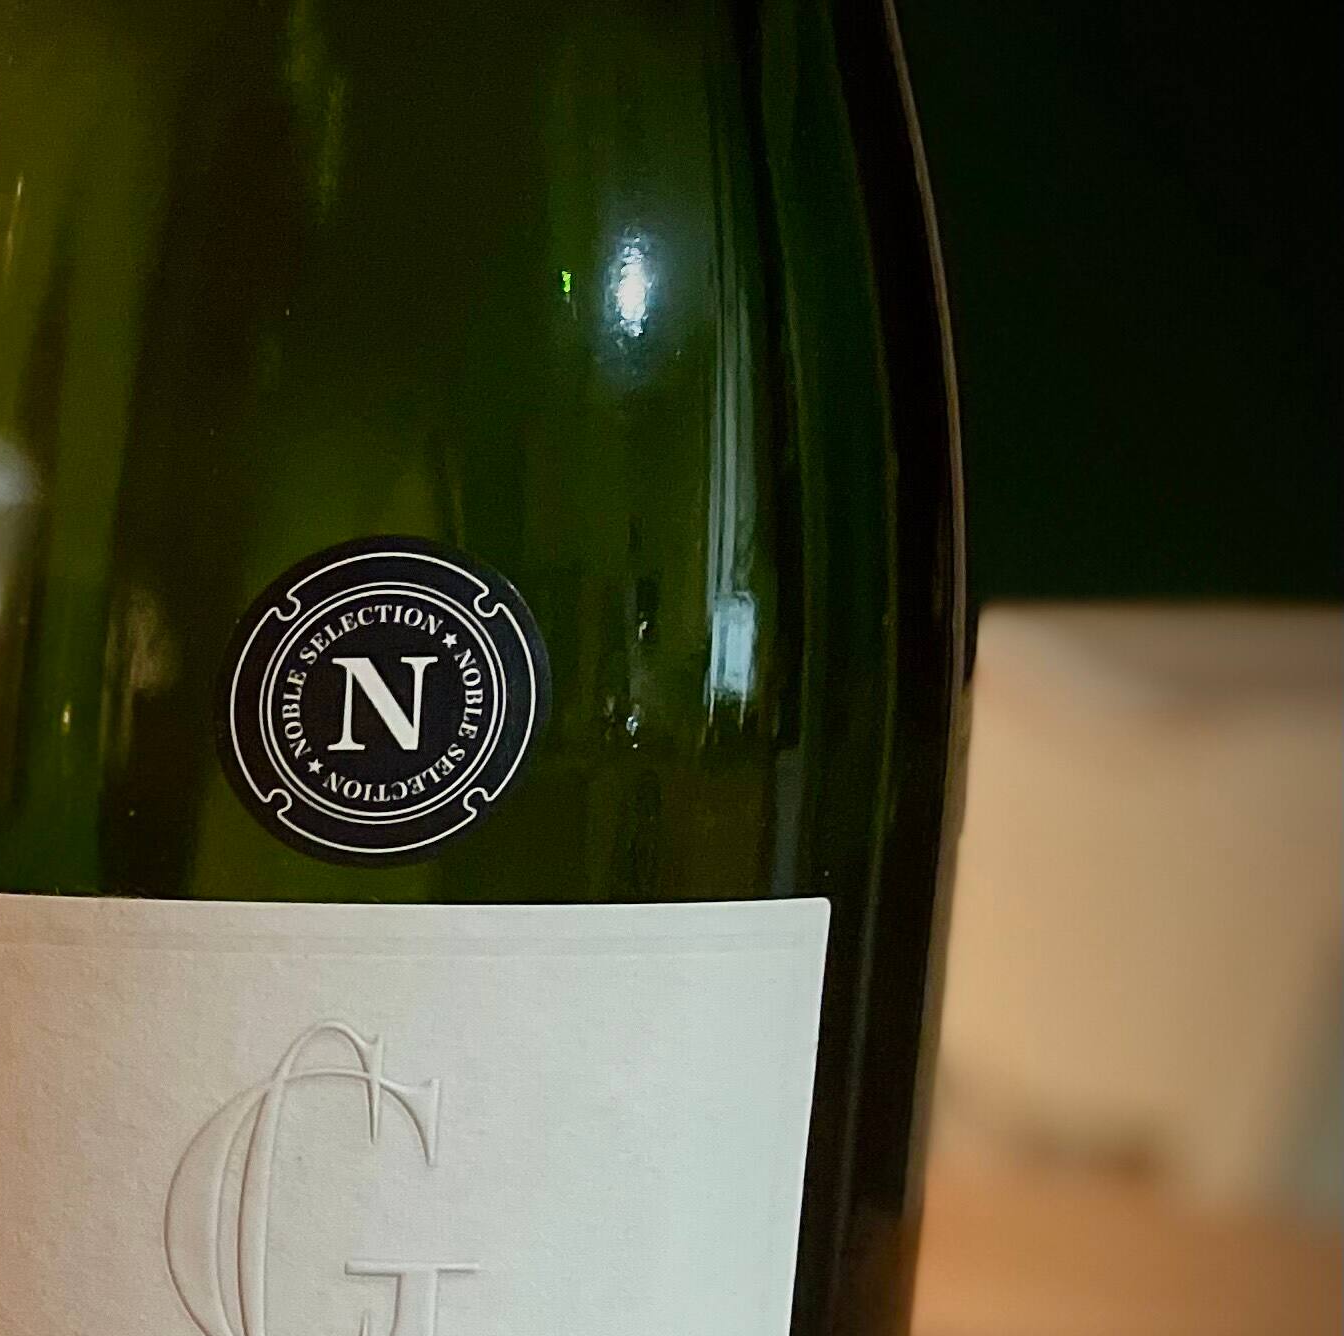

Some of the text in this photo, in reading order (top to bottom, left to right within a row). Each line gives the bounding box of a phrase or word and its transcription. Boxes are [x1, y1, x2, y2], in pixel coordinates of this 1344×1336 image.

[282, 604, 444, 759] NOBLE SELECTION
[323, 648, 483, 802] NOBLE SELECTION
[327, 656, 439, 751] N
